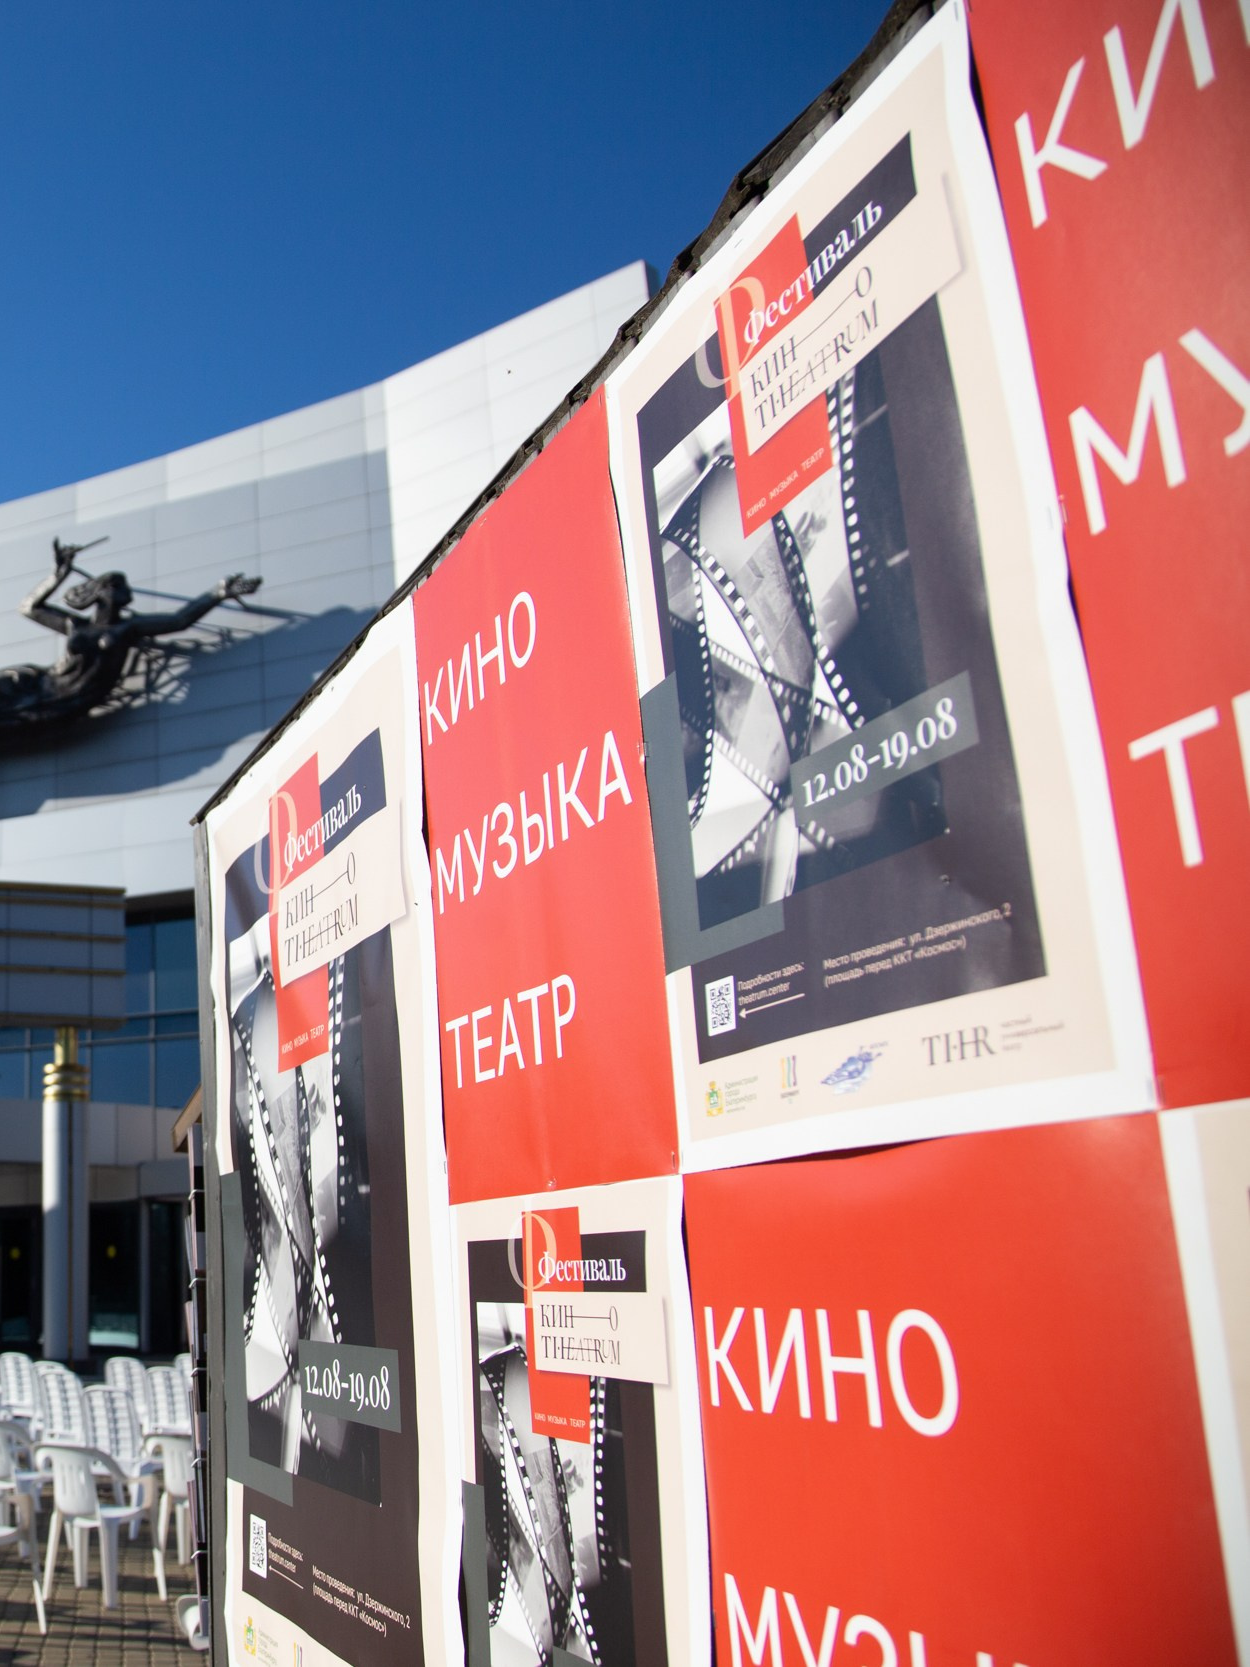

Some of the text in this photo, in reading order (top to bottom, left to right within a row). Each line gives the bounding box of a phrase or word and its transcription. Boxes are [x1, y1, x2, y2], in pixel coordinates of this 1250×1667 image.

[1014, 0, 1250, 229] КИ
[743, 200, 883, 345] Фестиваль
[746, 447, 824, 519] КИНО МУЗЫКА ТЕАТР
[424, 591, 537, 745] КИНО
[283, 784, 362, 873] Фестиваль
[435, 730, 633, 915] МУЗЫКА
[823, 902, 1012, 970] Место проведения: ул. Дзержинского, 2
[865, 959, 892, 975] перед
[893, 950, 914, 966] ККТ
[738, 970, 781, 991] Подробности
[738, 982, 790, 1006] theatrum.center
[310, 1024, 324, 1039] ТЕАТР
[446, 974, 577, 1088] ТЕАТР
[538, 1251, 627, 1284] Фестиваль
[703, 1306, 960, 1437] КИНО
[547, 1415, 568, 1425] МУЗЫКА
[570, 1418, 586, 1428] ТЕАТР
[312, 1564, 326, 1582] Место
[365, 1593, 405, 1628] Дзержинского,
[406, 1615, 410, 1628] 2
[333, 1596, 348, 1614] перед
